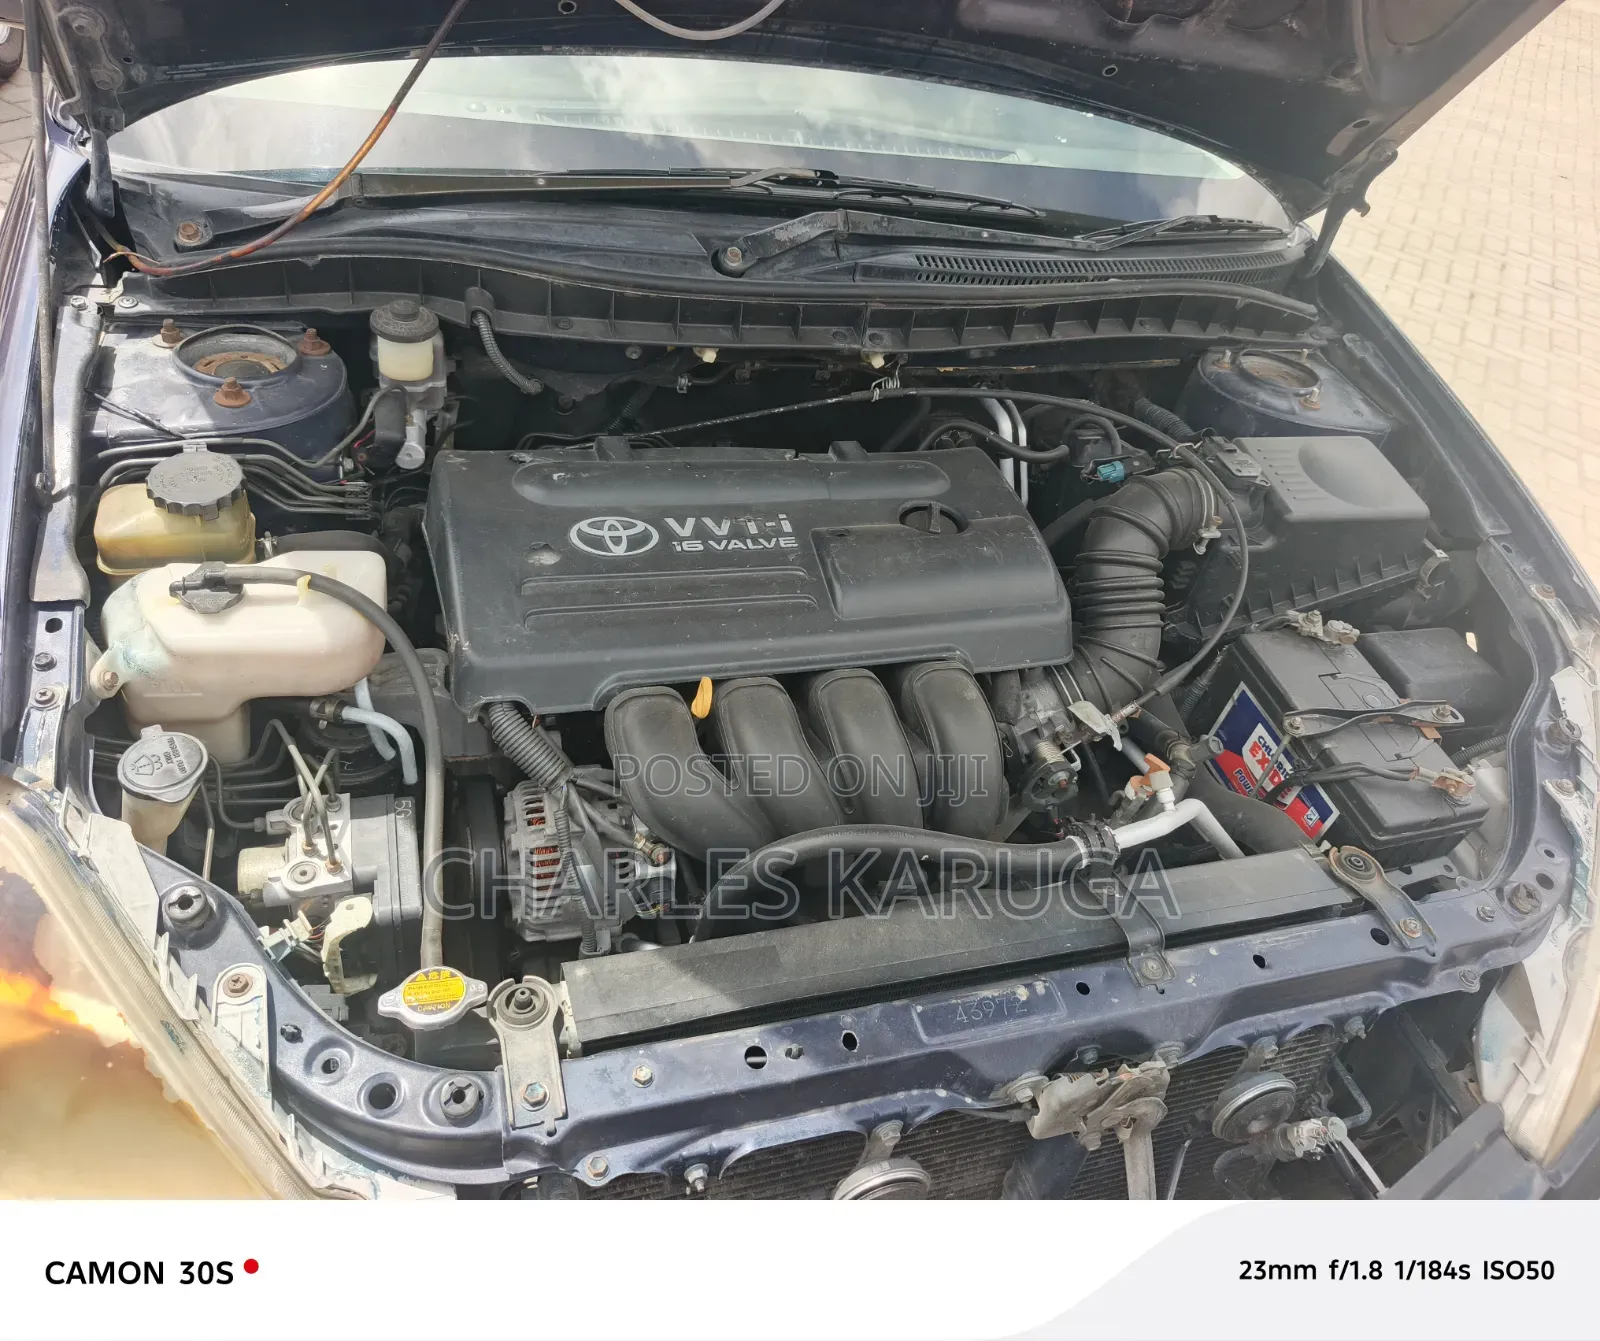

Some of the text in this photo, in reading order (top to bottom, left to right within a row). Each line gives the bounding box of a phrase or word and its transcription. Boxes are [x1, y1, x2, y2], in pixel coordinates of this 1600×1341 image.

[663, 513, 793, 538] VVT-i
[672, 537, 799, 552] 16 VALVE
[395, 799, 412, 818] 5G
[417, 1002, 451, 1012] CAUTION
[956, 996, 1028, 1023] 43972
